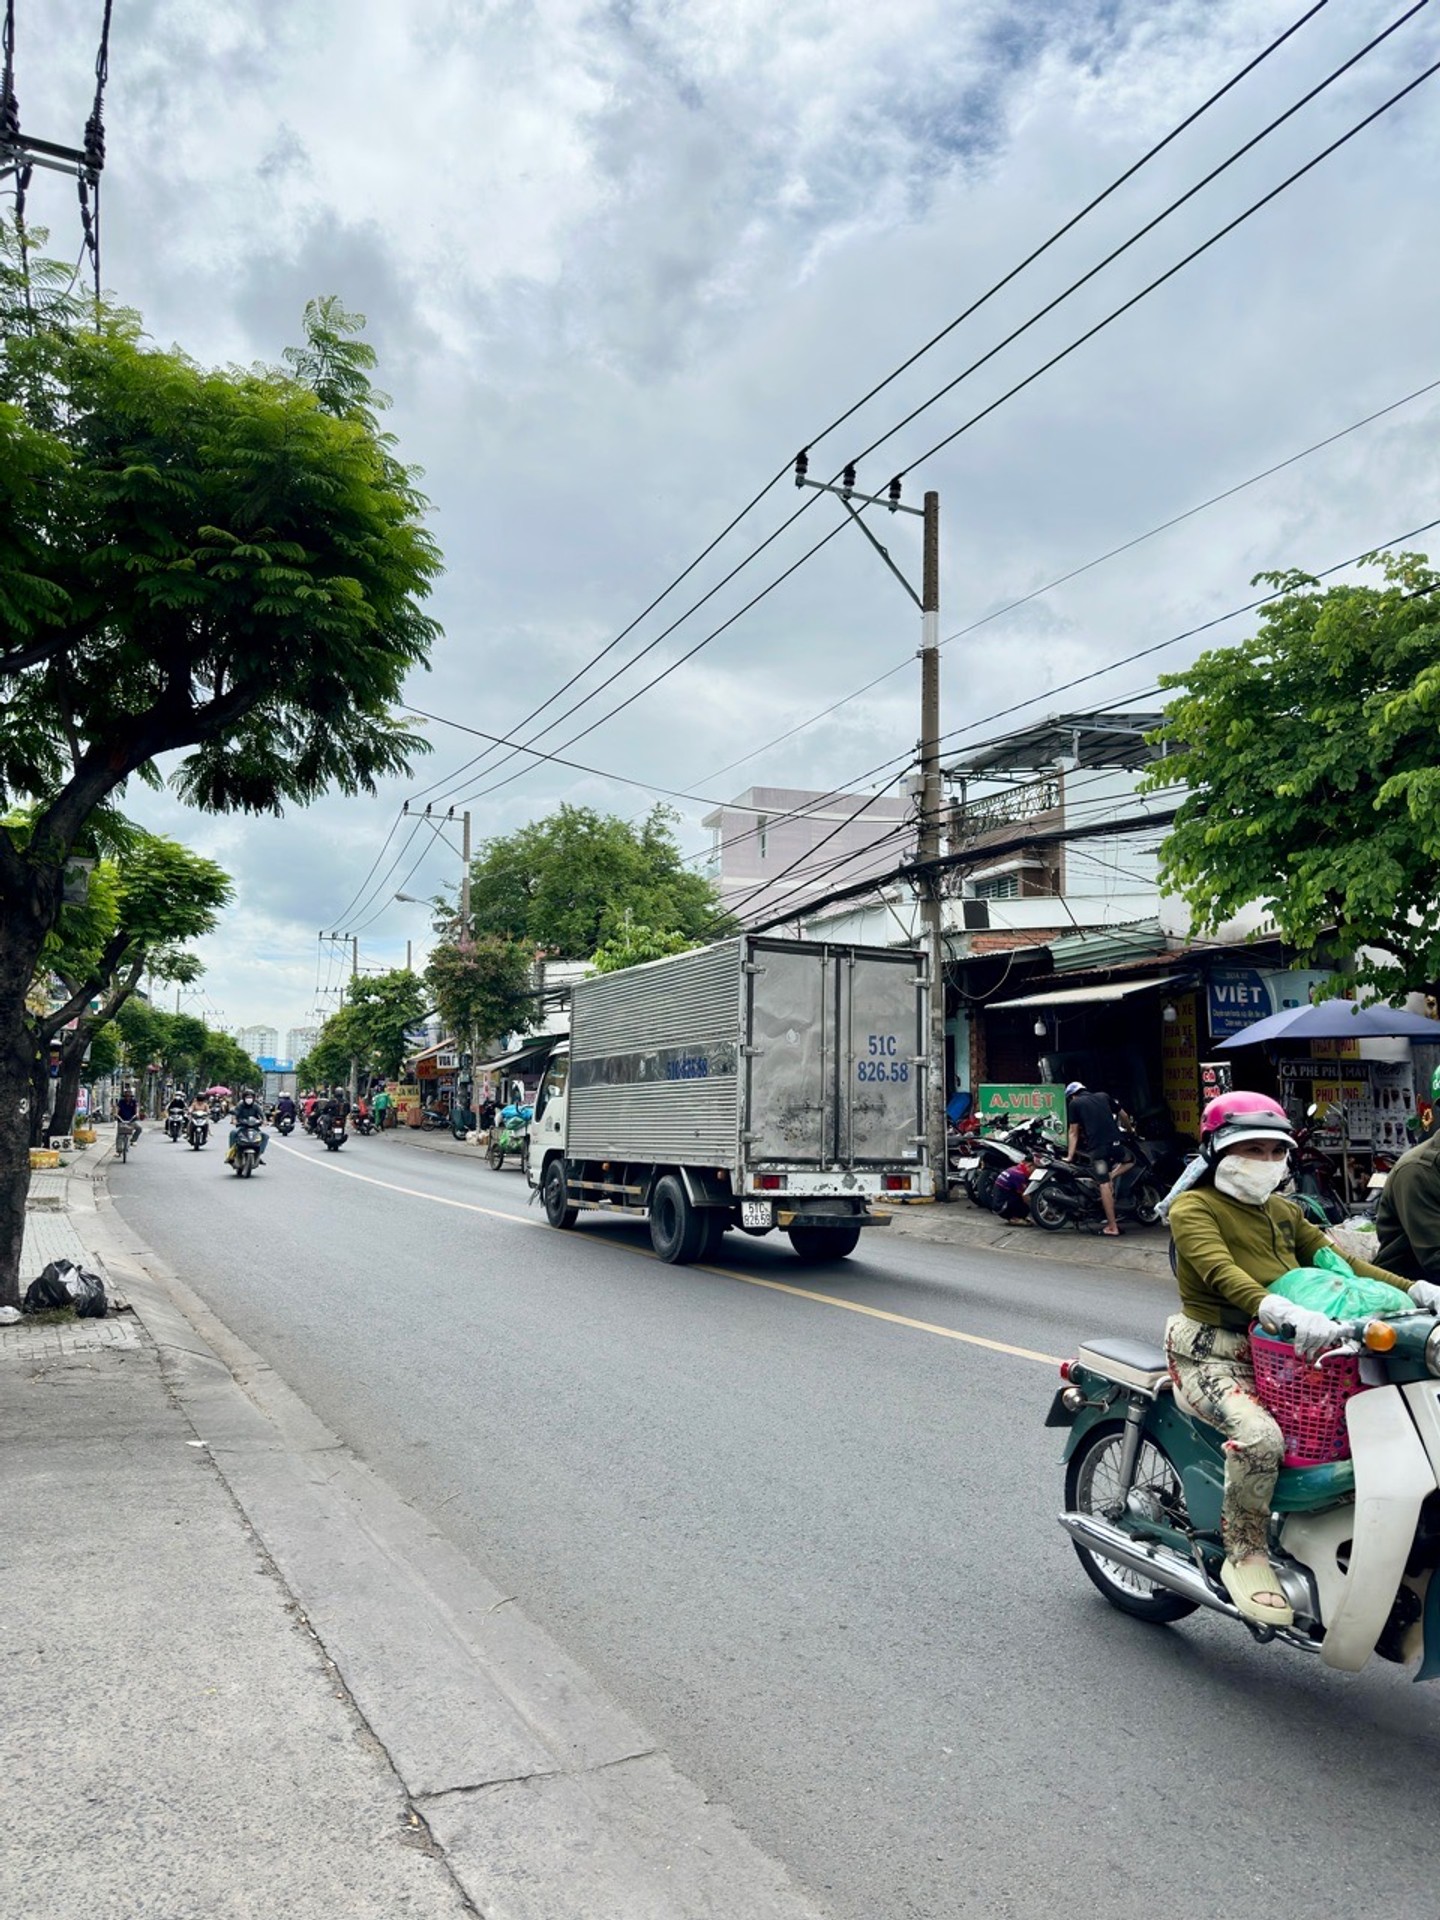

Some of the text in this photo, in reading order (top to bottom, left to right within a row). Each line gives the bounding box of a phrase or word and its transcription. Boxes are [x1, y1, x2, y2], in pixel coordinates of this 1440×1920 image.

[1214, 982, 1262, 1007] VIỆT
[868, 1034, 897, 1056] 51C
[858, 1061, 909, 1082] 826.58
[989, 1088, 1056, 1112] A.VIỆT
[748, 1202, 765, 1214] 51C
